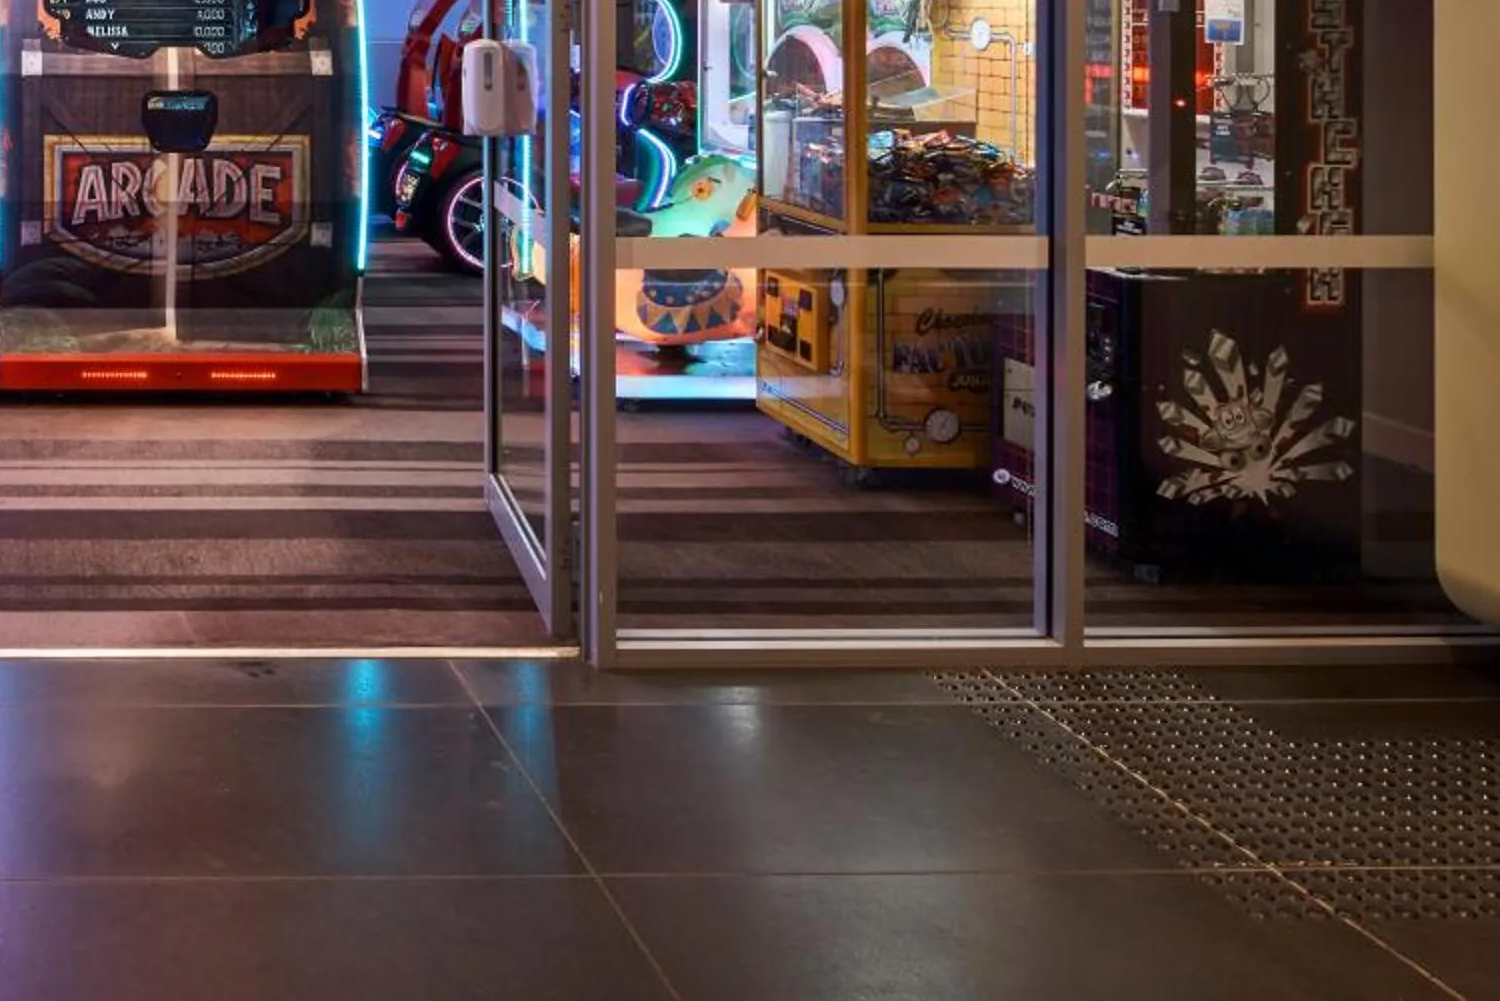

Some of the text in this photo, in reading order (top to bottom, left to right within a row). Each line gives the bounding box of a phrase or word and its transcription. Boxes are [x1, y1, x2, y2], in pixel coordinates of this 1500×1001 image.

[85, 7, 116, 20] ANDY
[86, 25, 129, 38] MELISSA
[71, 158, 283, 226] ARCADE
